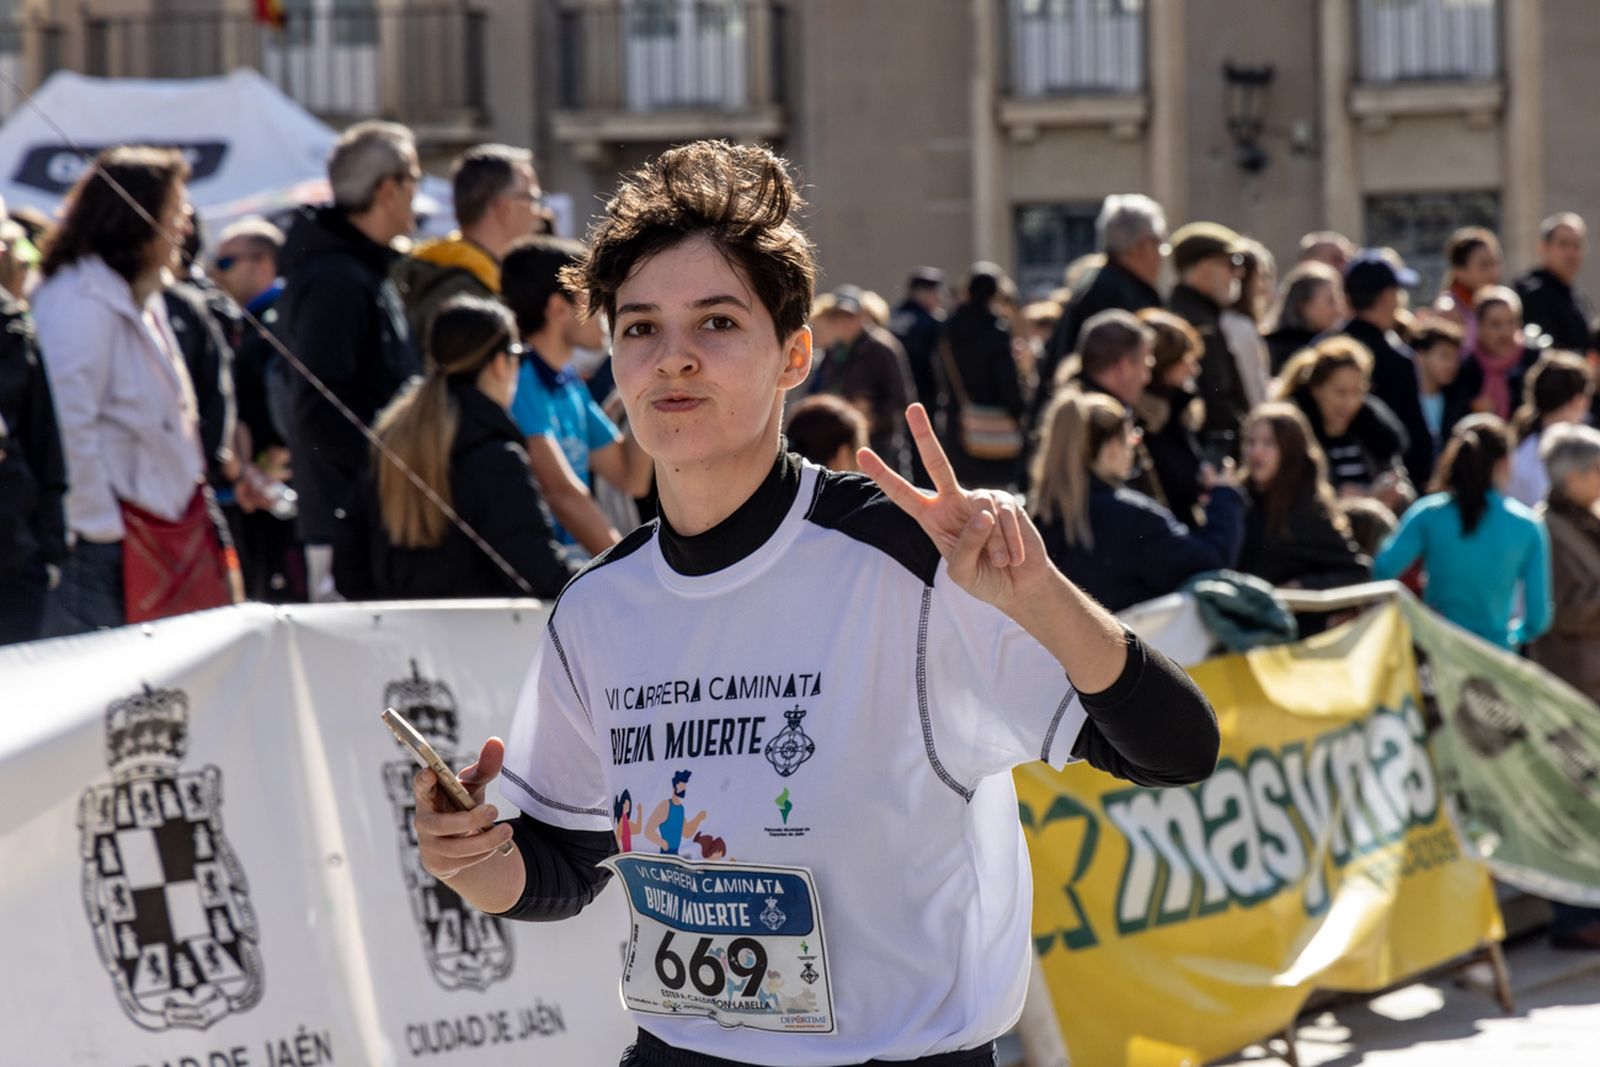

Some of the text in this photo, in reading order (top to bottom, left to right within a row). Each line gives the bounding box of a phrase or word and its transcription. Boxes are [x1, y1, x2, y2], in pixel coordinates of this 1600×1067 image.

[604, 671, 822, 711] VI CARRERA CAMINATA
[664, 716, 766, 760] MUERTE
[1101, 697, 1438, 937] masymas
[635, 865, 785, 894] VI CARRERA CAMINATA
[643, 886, 751, 927] BUENA MUERTE
[654, 930, 768, 997] 669
[733, 1000, 772, 1010] LABELLA
[265, 1024, 334, 1067] JAÉN
[406, 1014, 486, 1058] CIUDAD
